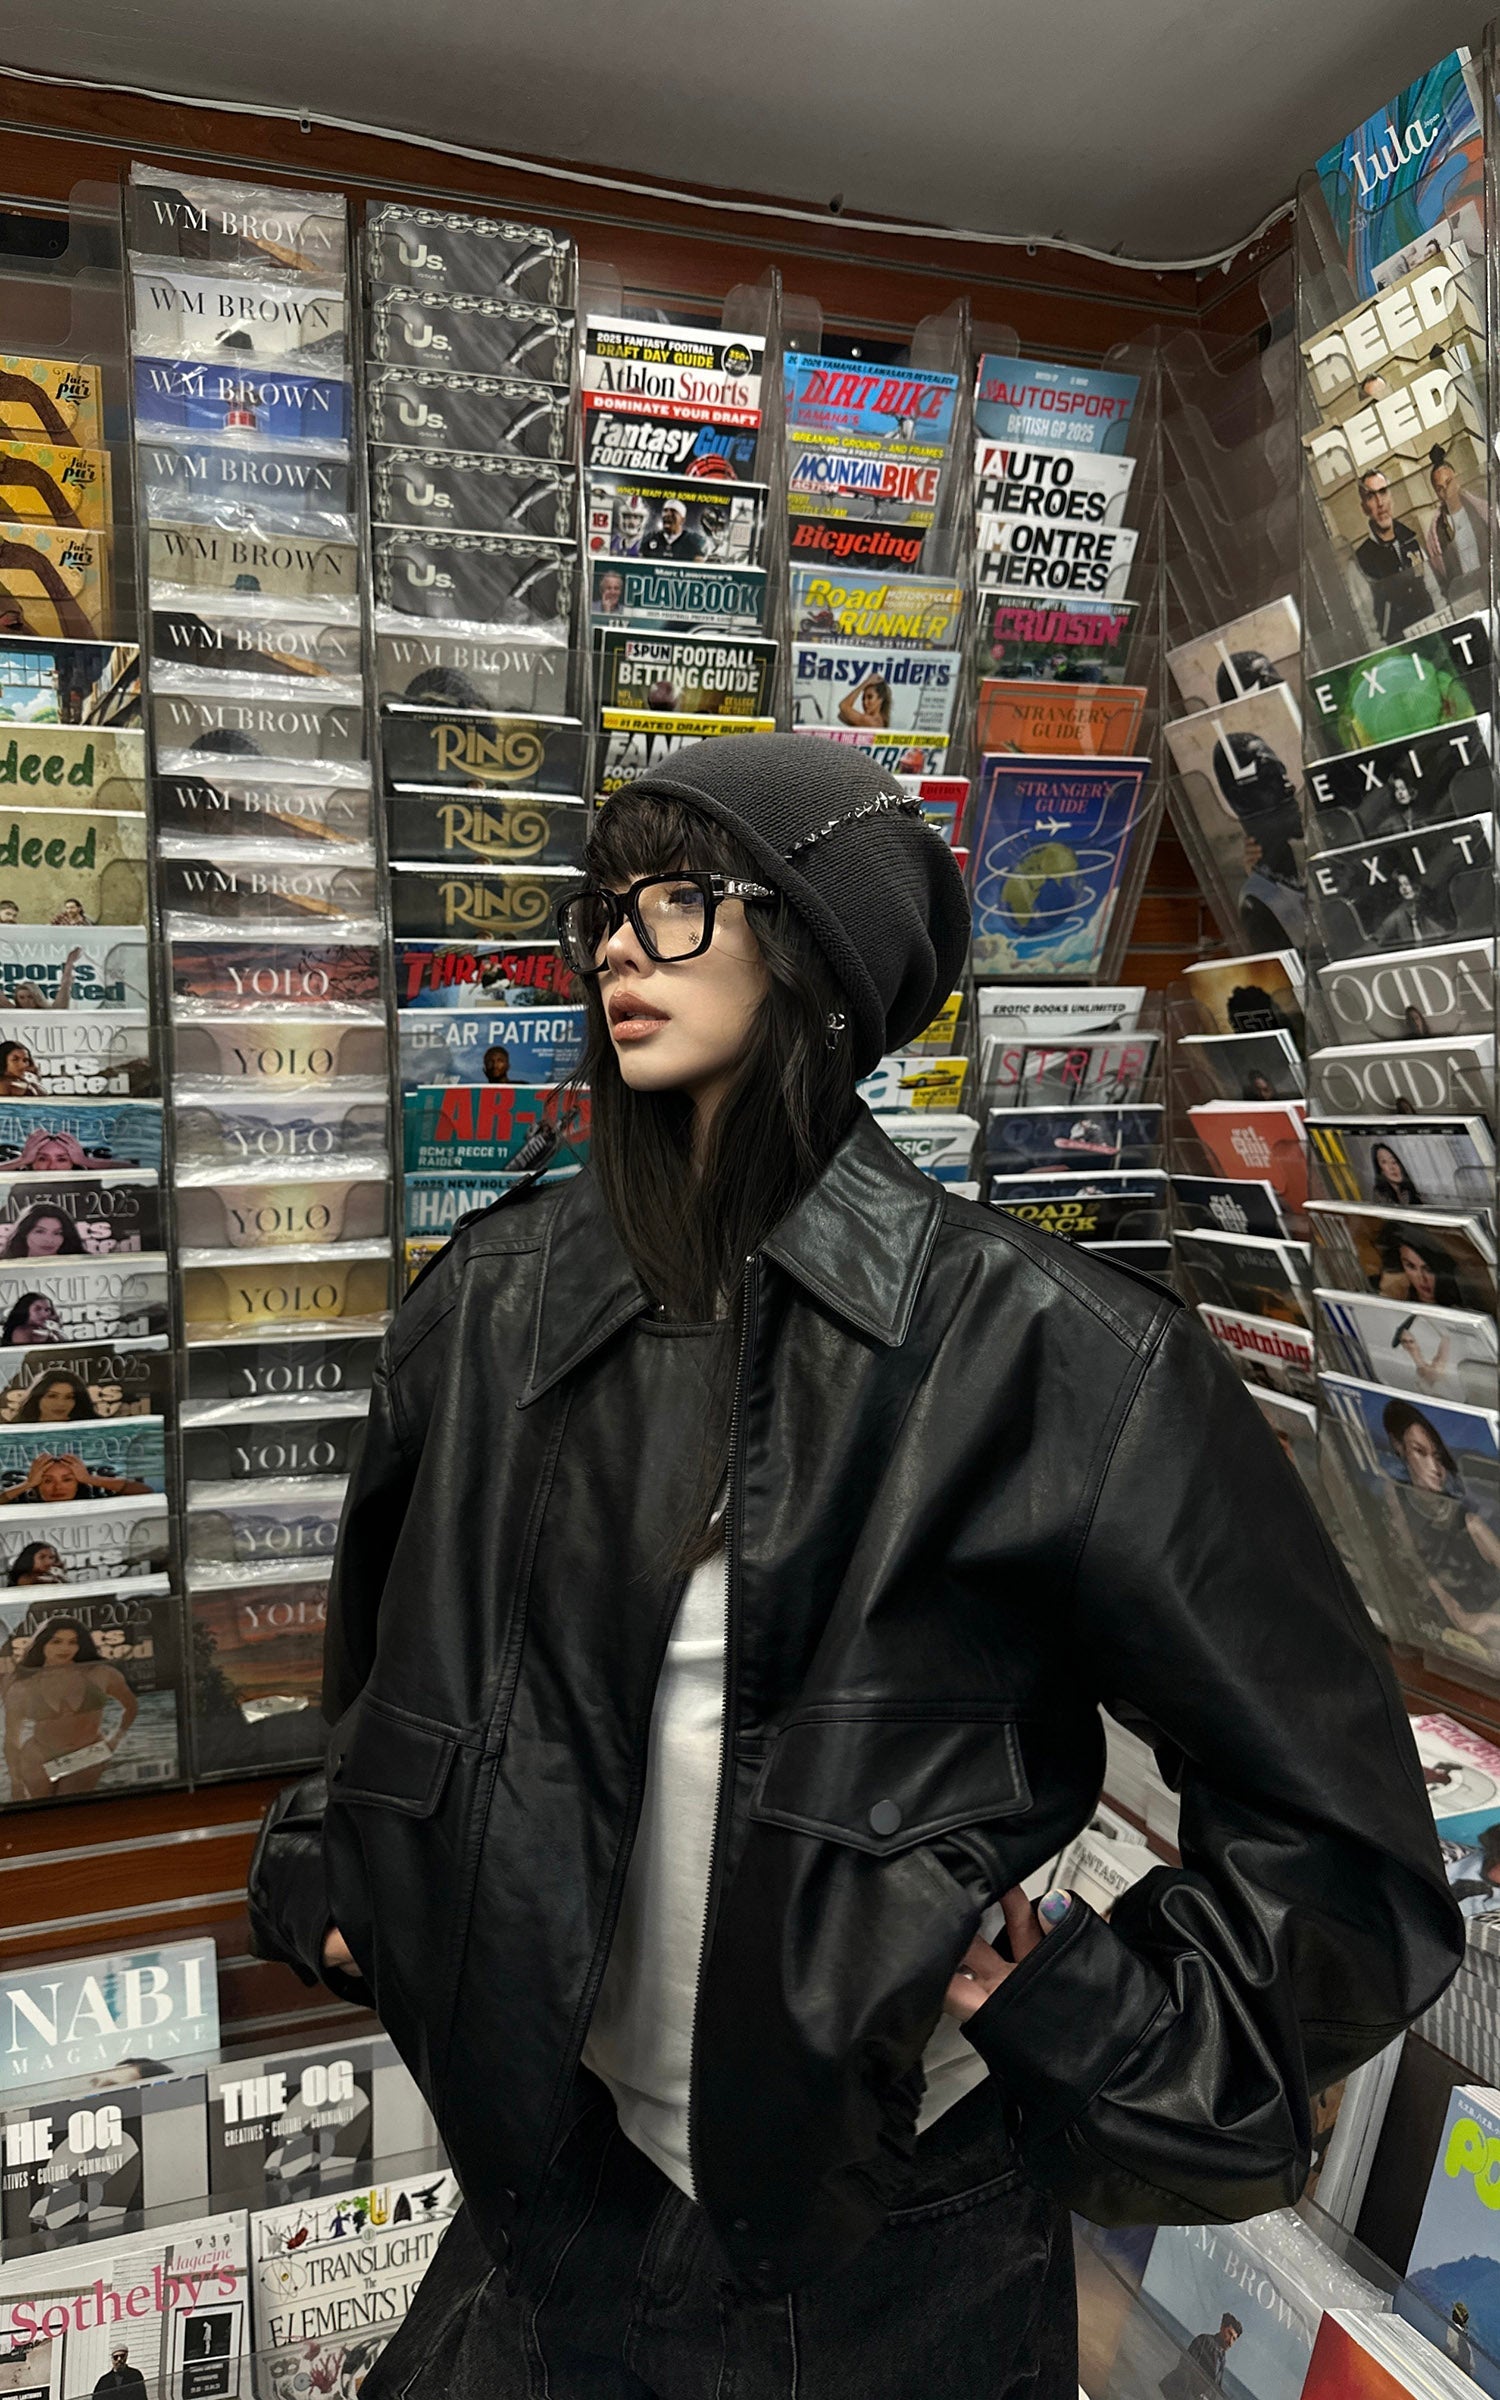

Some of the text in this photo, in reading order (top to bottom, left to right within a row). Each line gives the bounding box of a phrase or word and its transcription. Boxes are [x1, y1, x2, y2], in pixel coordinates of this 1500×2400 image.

[153, 201, 332, 250] WM BROWN
[150, 287, 330, 328] WM BROWN
[597, 343, 640, 360] DRAFT
[643, 348, 670, 362] DAY
[674, 351, 714, 369] GUIDE
[624, 336, 667, 350] FANTASY
[669, 341, 714, 356] FOOTBALL
[150, 369, 330, 411] WM BROWN
[597, 361, 749, 407] Athlon Sports
[801, 370, 950, 420] DIRT BIKE
[994, 383, 1130, 419] AUTOSPORT
[594, 396, 757, 426] DOMINATE YOUR DRAFT
[1050, 421, 1066, 439] GP
[1066, 423, 1095, 443] 2025
[152, 453, 333, 490] WM BROWN
[591, 447, 669, 471] FOOTBALL
[982, 448, 1074, 487] AUTO
[976, 480, 1107, 523] HEROES
[164, 533, 344, 576] WM BROWN
[792, 525, 922, 564] Bicycling
[986, 522, 1117, 562] MONTRE
[979, 553, 1110, 592] HEROES
[625, 575, 759, 616] PLAYBOOK
[804, 579, 889, 611] Road
[168, 624, 348, 658] WM BROWN
[838, 611, 948, 639] RUNNER
[391, 641, 557, 676] WM BROWN
[631, 645, 756, 670] SPUN FOOTBALL
[797, 651, 950, 687] Easyriders
[1315, 633, 1473, 714] EXIT
[618, 663, 760, 692] BETTING GUIDE
[170, 704, 350, 739] WM BROWN
[1032, 723, 1086, 740] GUIDE
[1312, 736, 1471, 803] EXIT
[175, 787, 355, 820] WM BROWN
[1035, 799, 1087, 815] GUIDE
[1315, 835, 1474, 895] EXIT
[182, 870, 362, 898] WM BROWN
[227, 966, 330, 997] YOLO
[993, 1003, 1127, 1014] EROTIC BOOKS UNLIMITED
[411, 1020, 582, 1049] GEAR PATROL
[232, 1048, 334, 1076] YOLO
[233, 1128, 334, 1156] YOLO
[457, 1146, 495, 1157] RECCE
[448, 1180, 477, 1189] NEW
[229, 1204, 331, 1235] YOLO
[238, 1285, 338, 1314] YOLO
[1207, 1313, 1312, 1373] Lightning
[242, 1362, 342, 1392] YOLO
[236, 1441, 335, 1471] YOLO
[5, 1957, 208, 2053] NABI
[11, 2023, 206, 2076] MAGAZINE
[220, 2060, 354, 2124] THE OG
[68, 2105, 122, 2154] OG
[224, 2105, 354, 2148] CREATIVES CULTURE COMMUNITY
[37, 2163, 70, 2185] CULTURE
[78, 2153, 124, 2177] COMMUNITY
[169, 2248, 233, 2273] Magazine
[306, 2232, 433, 2288] TRANSLIGHT
[364, 2276, 376, 2290] The
[10, 2263, 238, 2348] Sotheby's
[269, 2287, 397, 2349] ELEMENTS
